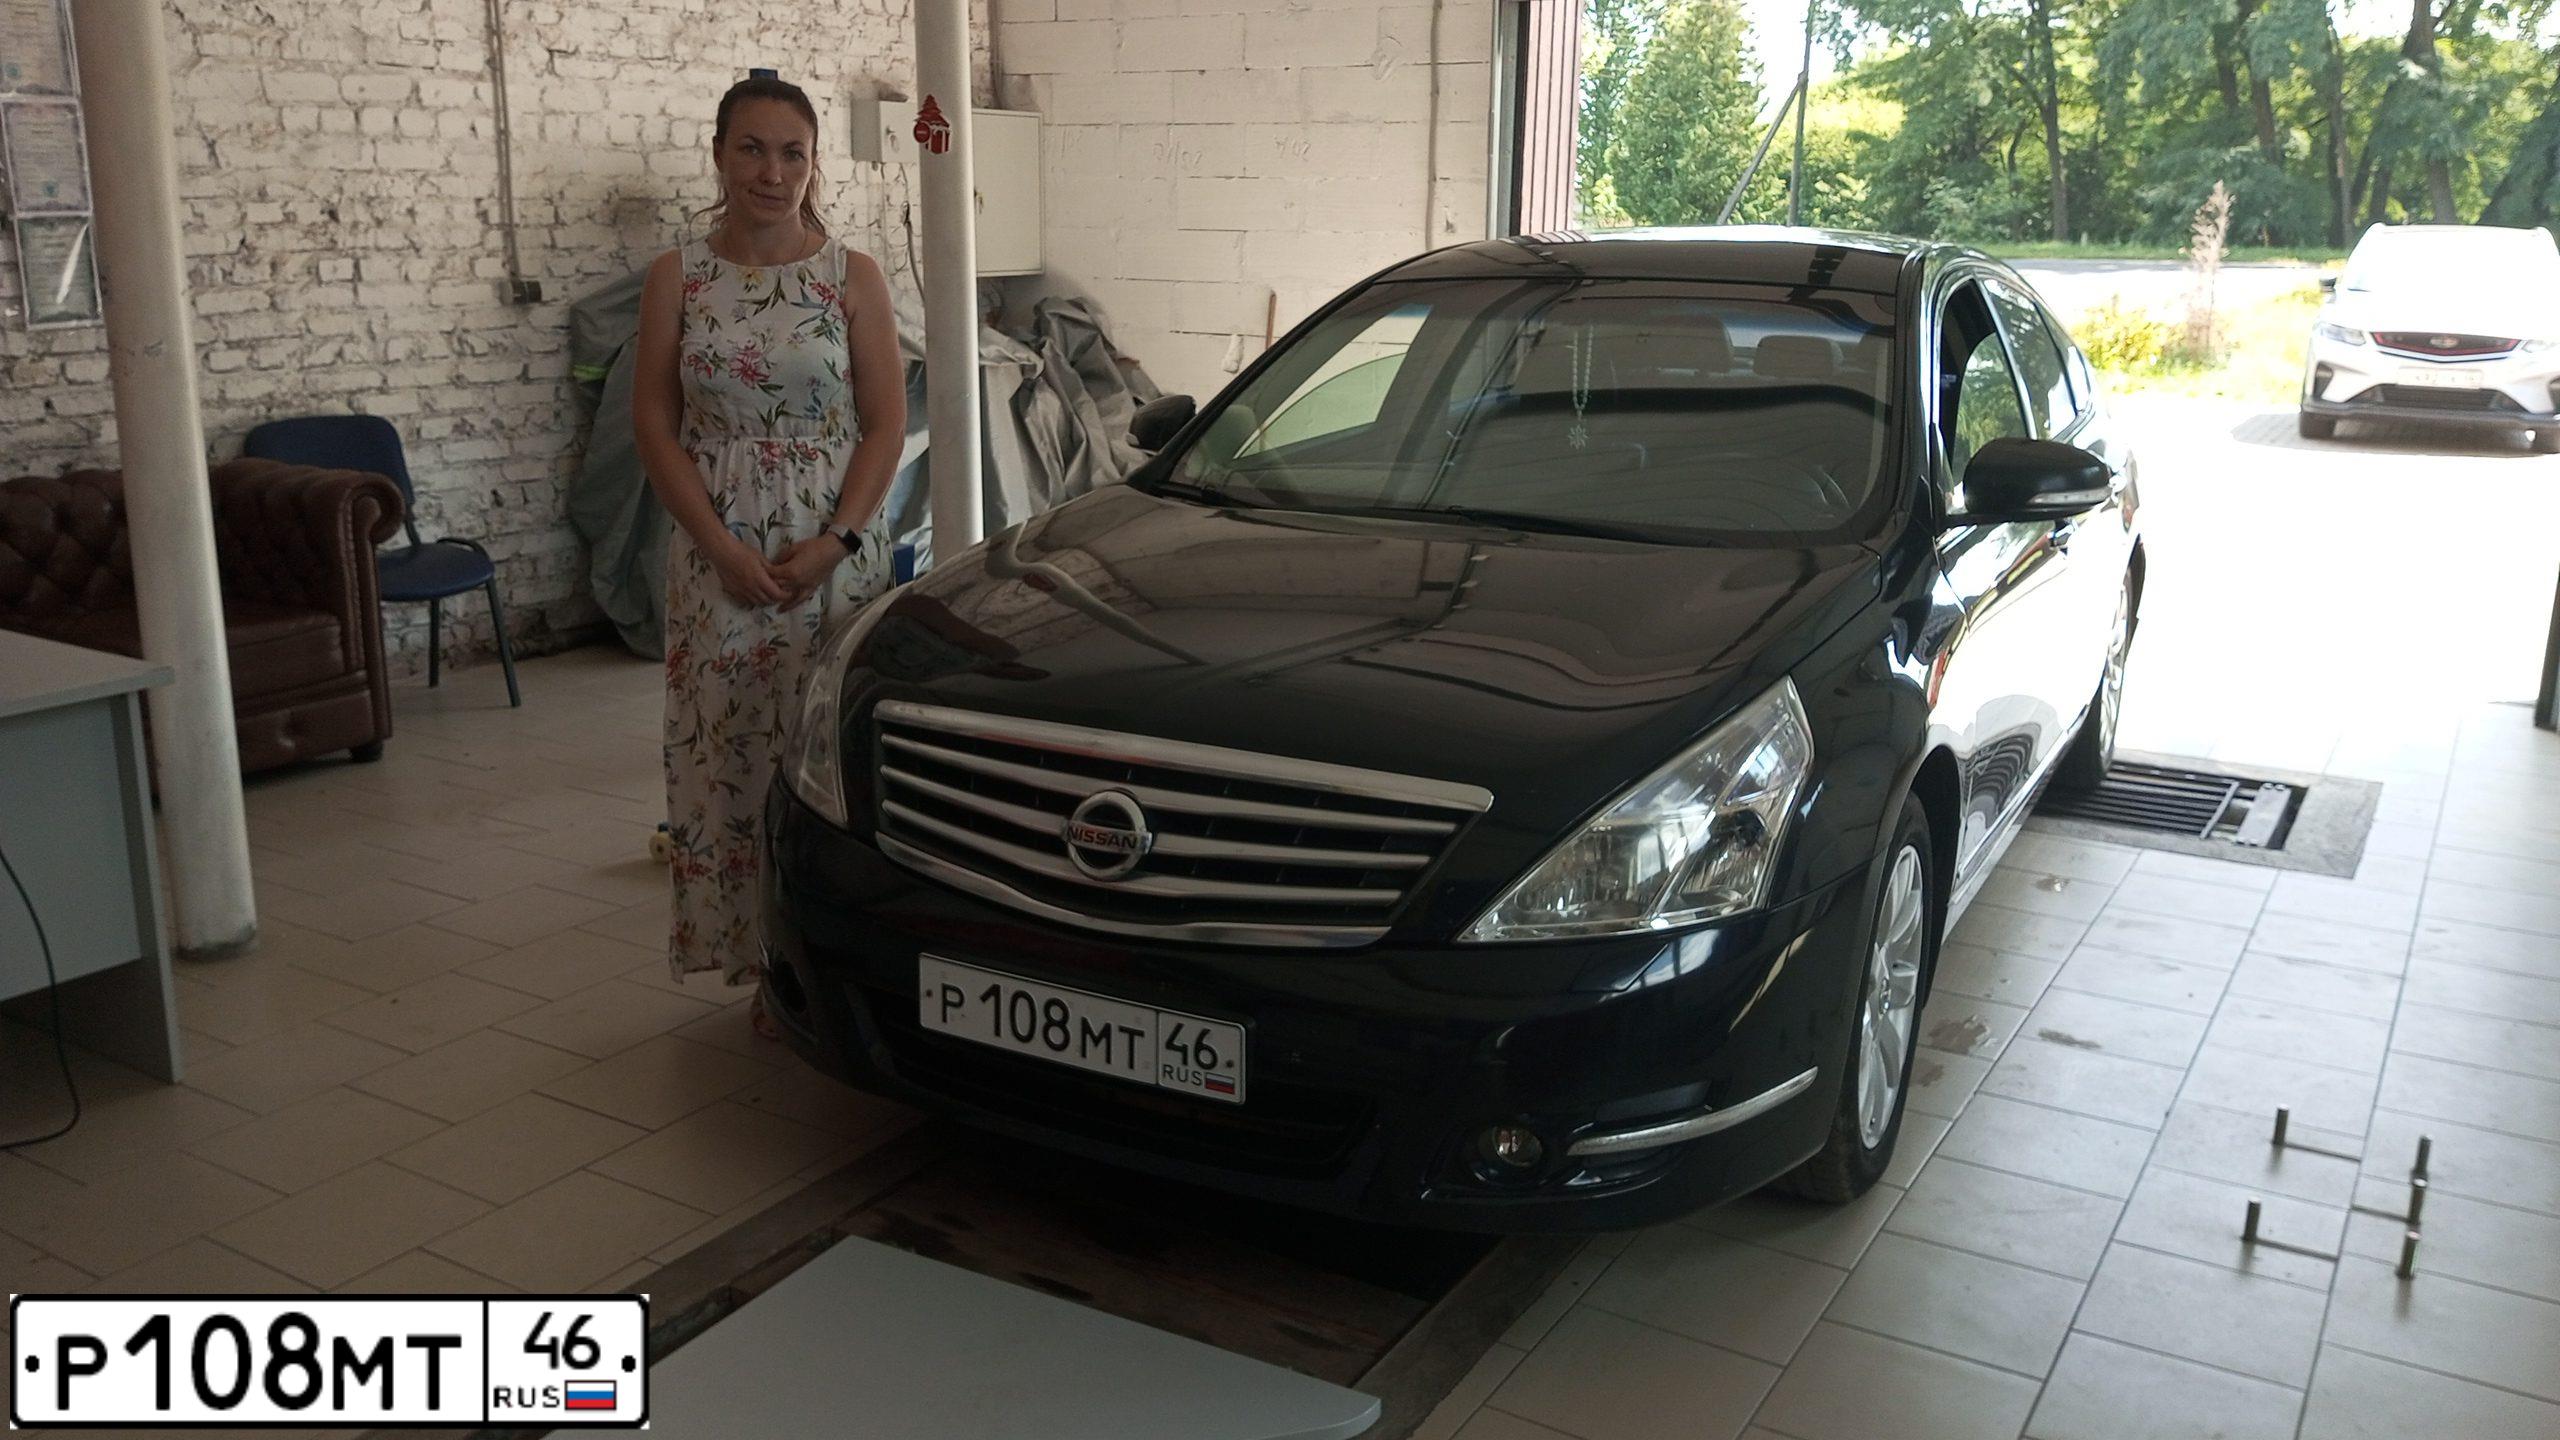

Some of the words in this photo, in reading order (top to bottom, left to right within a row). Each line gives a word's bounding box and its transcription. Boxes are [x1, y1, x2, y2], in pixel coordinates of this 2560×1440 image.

[1067, 825, 1138, 850] NISSAN
[1164, 1022, 1218, 1070] 46
[1162, 1063, 1202, 1086] RUS
